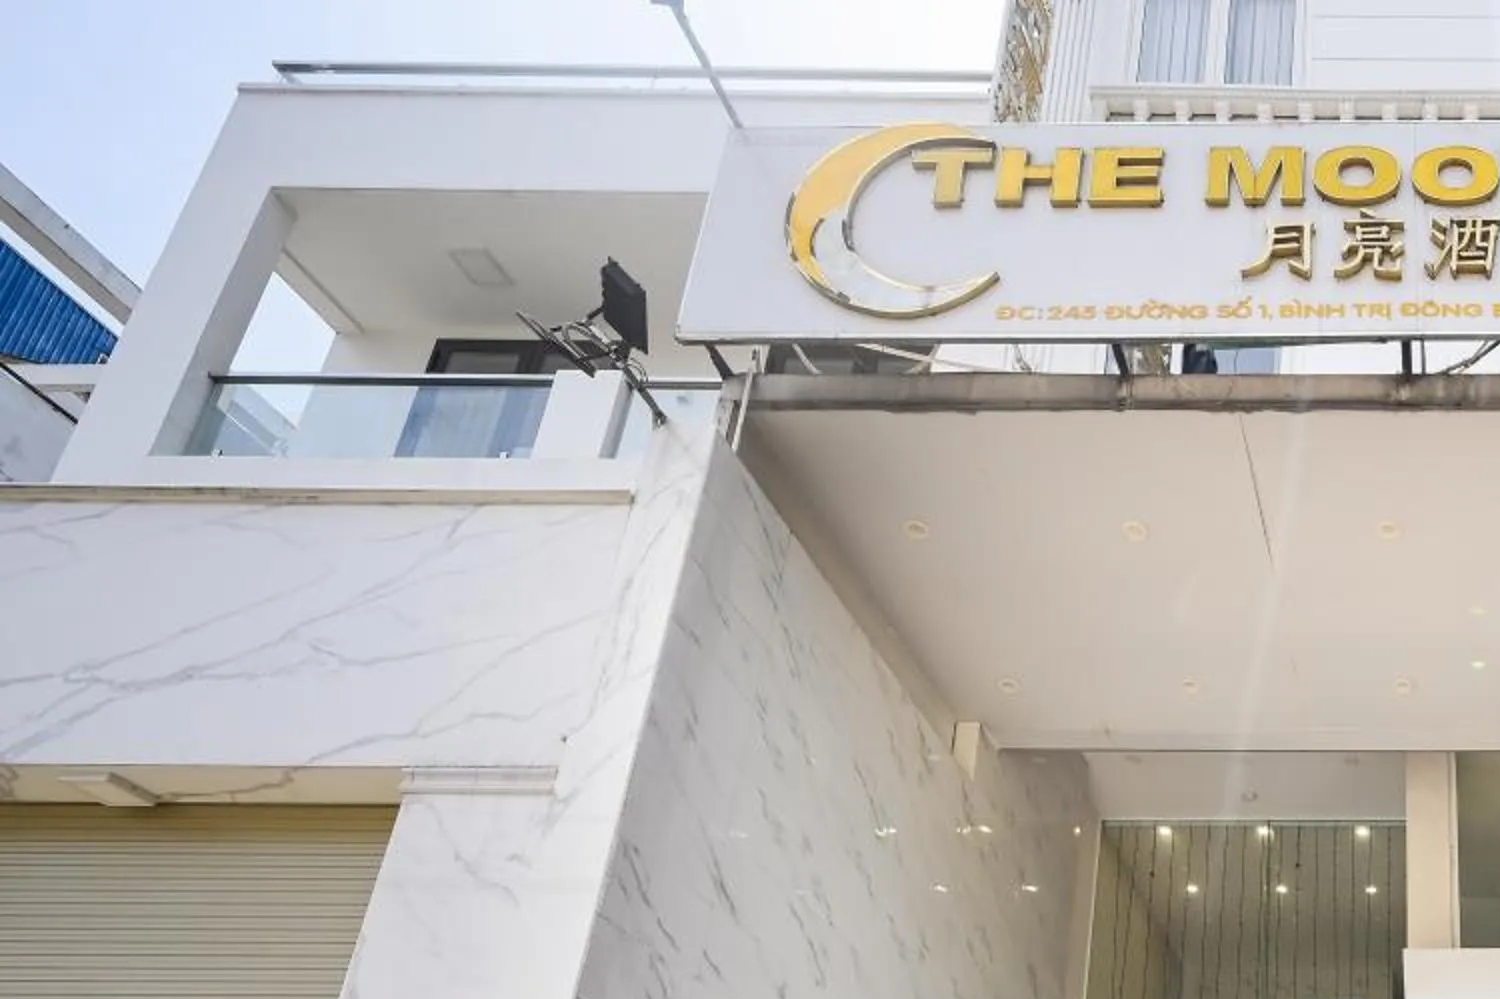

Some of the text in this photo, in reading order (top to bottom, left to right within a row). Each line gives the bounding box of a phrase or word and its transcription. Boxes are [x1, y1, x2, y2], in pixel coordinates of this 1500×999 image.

[911, 147, 1165, 208] THE
[1104, 298, 1208, 321] ĐƯỜNG
[1216, 295, 1253, 320] SỐ
[1279, 297, 1345, 320] BÌNH
[1352, 303, 1391, 321] TRỊ
[1400, 299, 1484, 318] ĐÔNG
